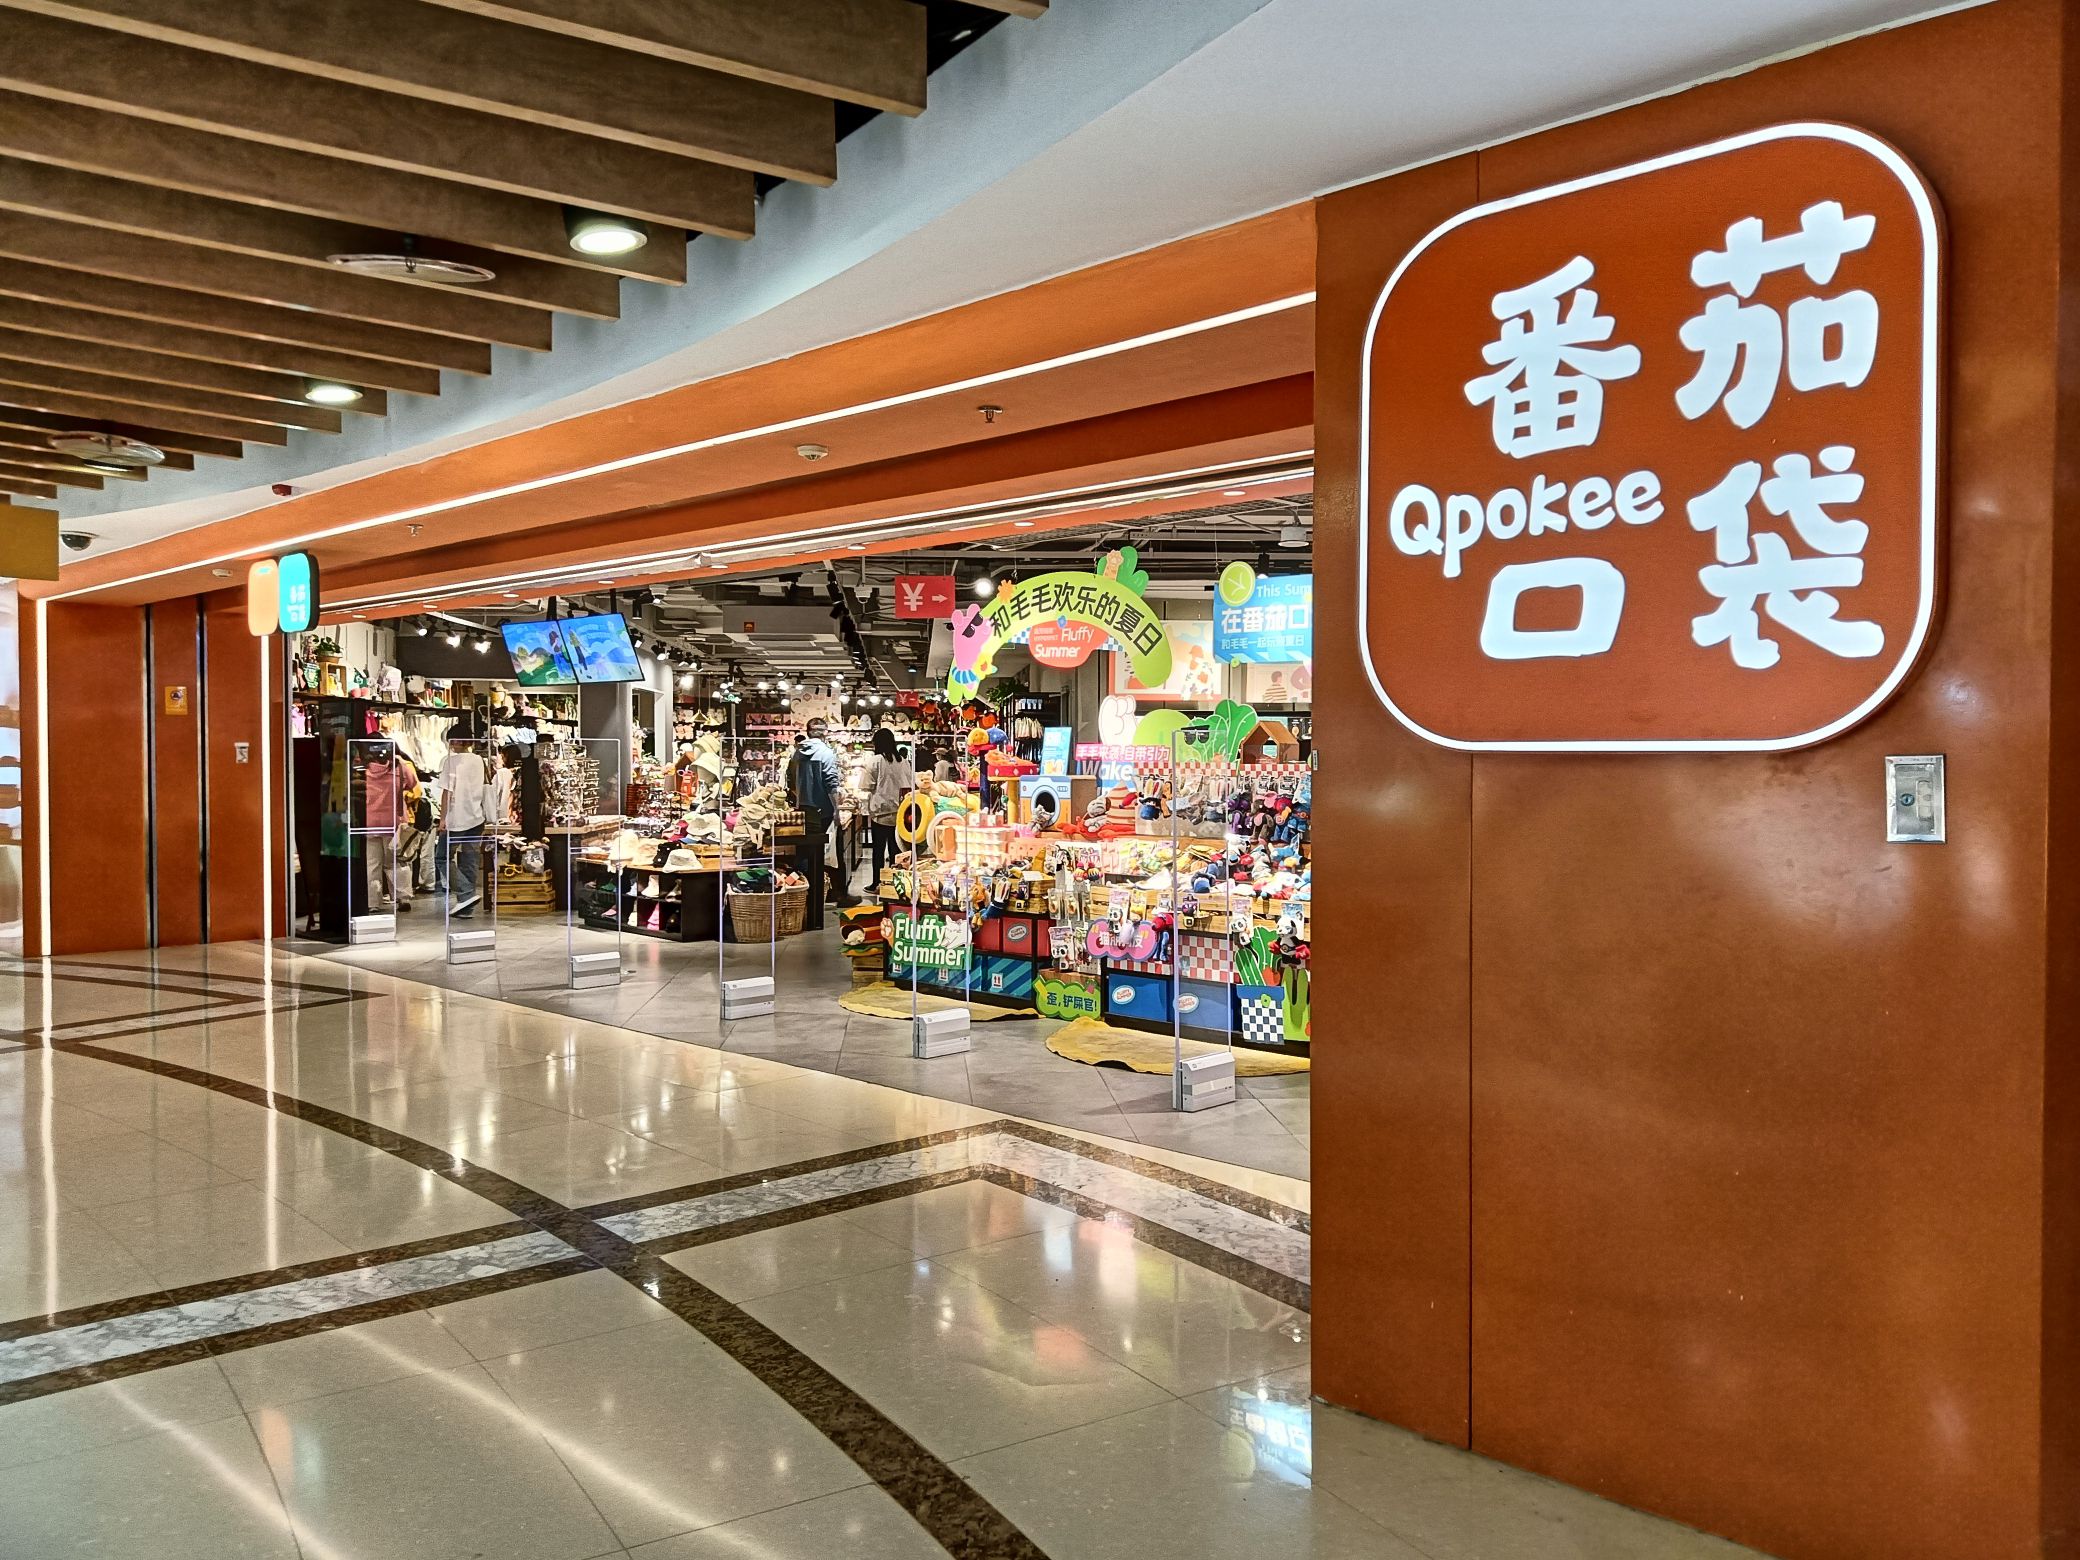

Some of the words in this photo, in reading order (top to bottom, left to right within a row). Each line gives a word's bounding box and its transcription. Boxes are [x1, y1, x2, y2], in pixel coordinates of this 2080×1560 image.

[1390, 470, 1665, 577] Qpokee
[1257, 584, 1280, 597] This
[989, 581, 1163, 656] 和毛毛欢乐的夏日
[1061, 626, 1095, 642] Fluffy
[1035, 644, 1080, 658] Summer
[1082, 760, 1133, 780] Wake
[895, 917, 947, 947] Fluffy
[893, 942, 965, 966] Summer
